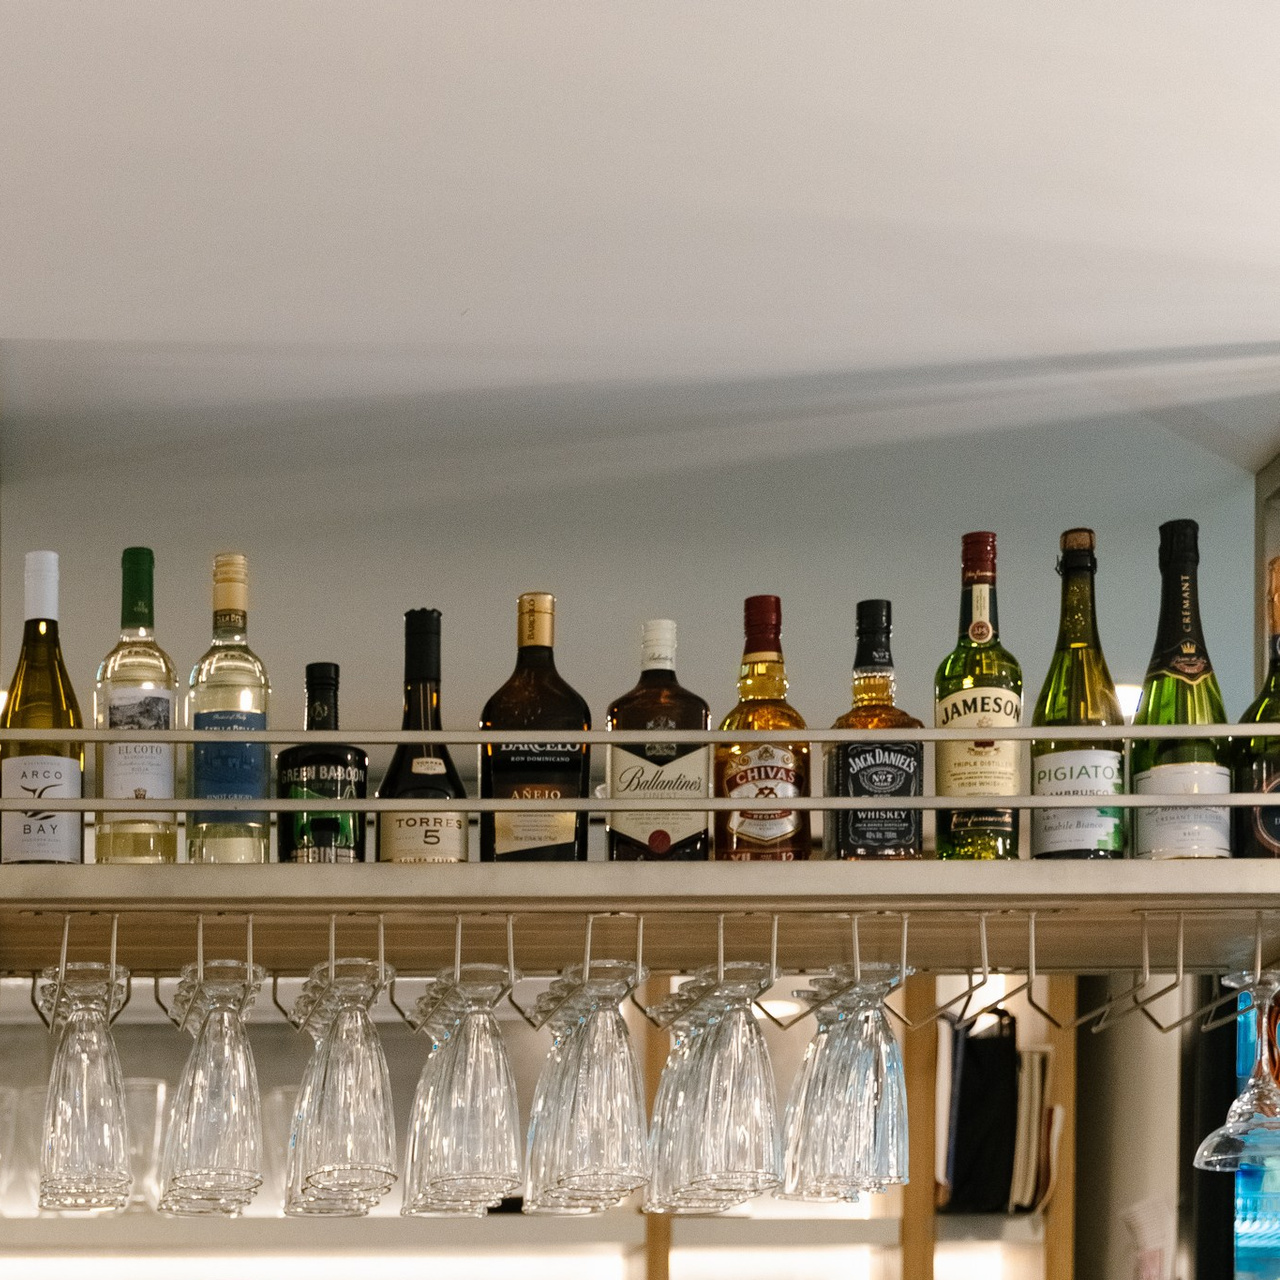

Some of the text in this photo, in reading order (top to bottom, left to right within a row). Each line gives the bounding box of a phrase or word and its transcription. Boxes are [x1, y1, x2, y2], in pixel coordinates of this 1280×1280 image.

[942, 696, 1021, 725] JAMESON
[118, 745, 162, 755] EL COTO
[848, 748, 918, 774] JACK DANIEL'S
[20, 770, 63, 780] ARCO
[281, 765, 365, 784] GREEN BABOON
[617, 765, 702, 793] Ballantine's
[736, 766, 796, 784] CHIVAS
[1038, 765, 1115, 784] PIGIATO
[857, 810, 907, 819] WHISKEY
[23, 824, 59, 835] BAY
[396, 817, 462, 830] TORRES
[423, 829, 441, 845] 5
